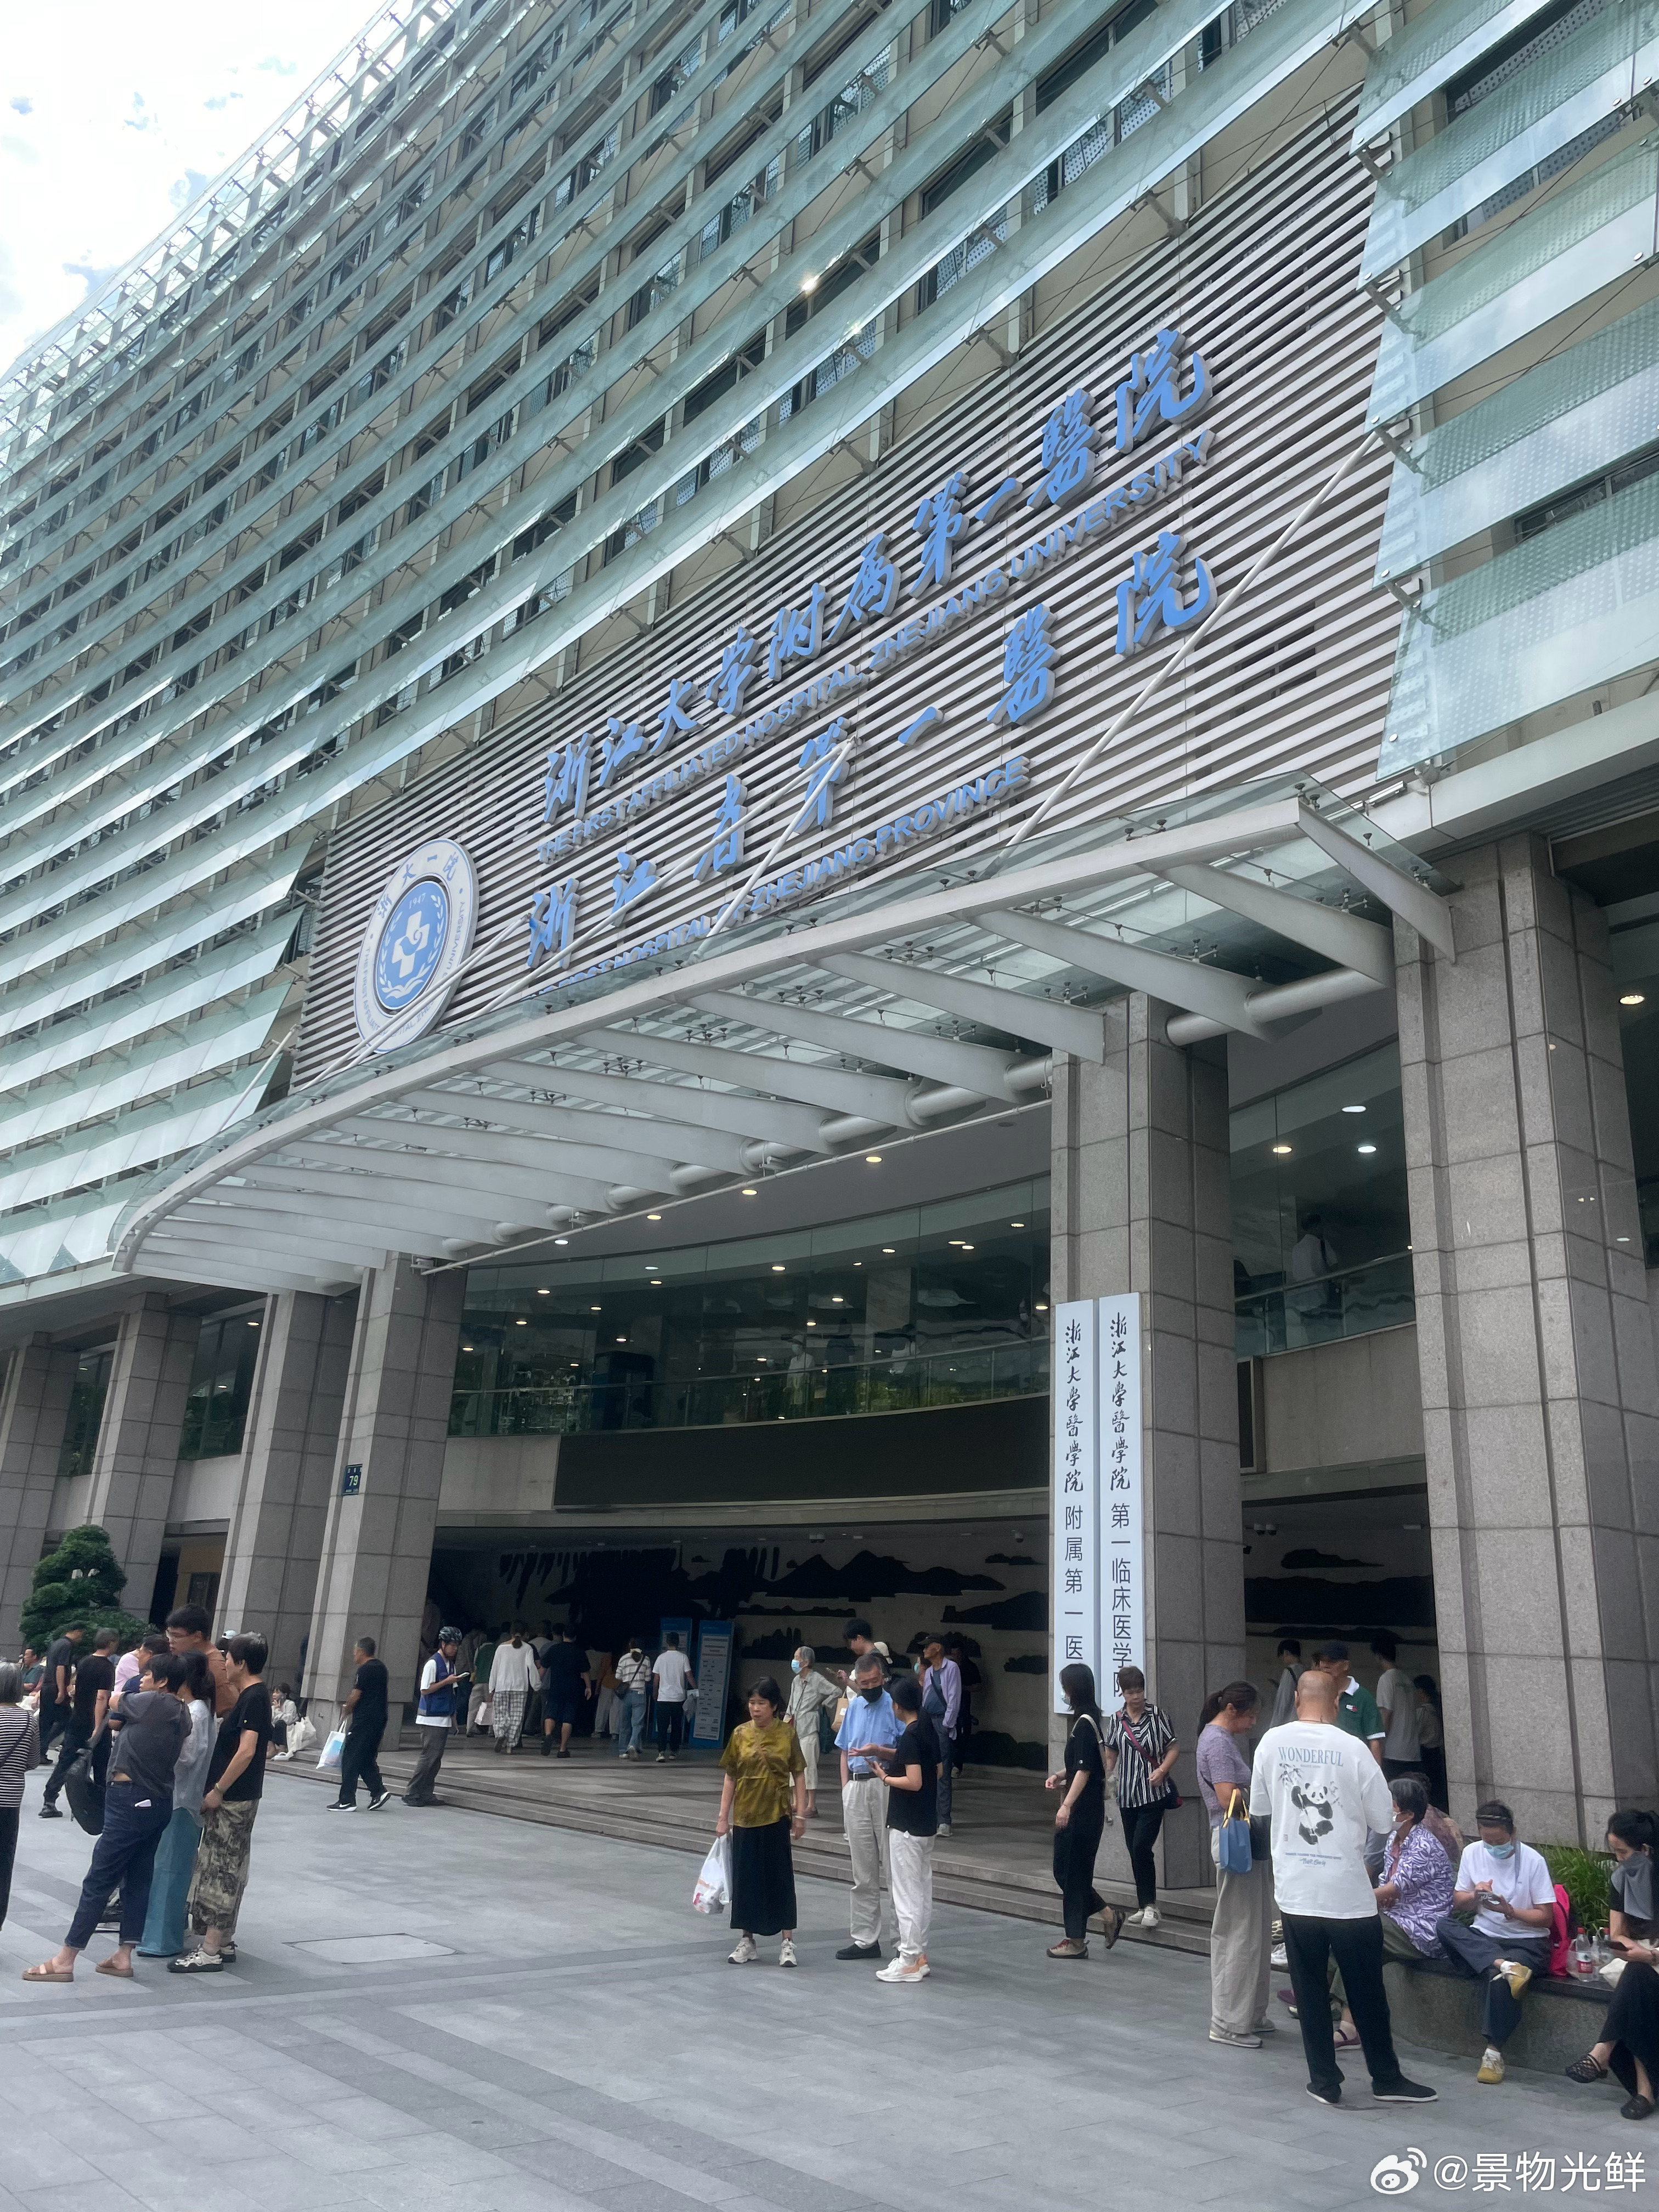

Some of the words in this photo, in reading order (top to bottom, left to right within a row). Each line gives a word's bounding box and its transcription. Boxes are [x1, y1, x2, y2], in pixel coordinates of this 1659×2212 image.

[537, 830, 571, 862] THE
[573, 799, 627, 844] FIRST
[627, 733, 741, 814] AFFILIATED
[744, 663, 865, 744] HOSPITAL,
[869, 568, 1006, 669] ZHEJIANG
[1011, 428, 1212, 578] UNIVERSITY
[614, 915, 710, 969] HOSPITAL
[750, 838, 871, 912] ZHEJIANG
[876, 755, 1026, 852] PROVINCE
[409, 893, 426, 909] 1947
[349, 1475, 359, 1487] 79
[1278, 1747, 1344, 1767] WONDERFUL
